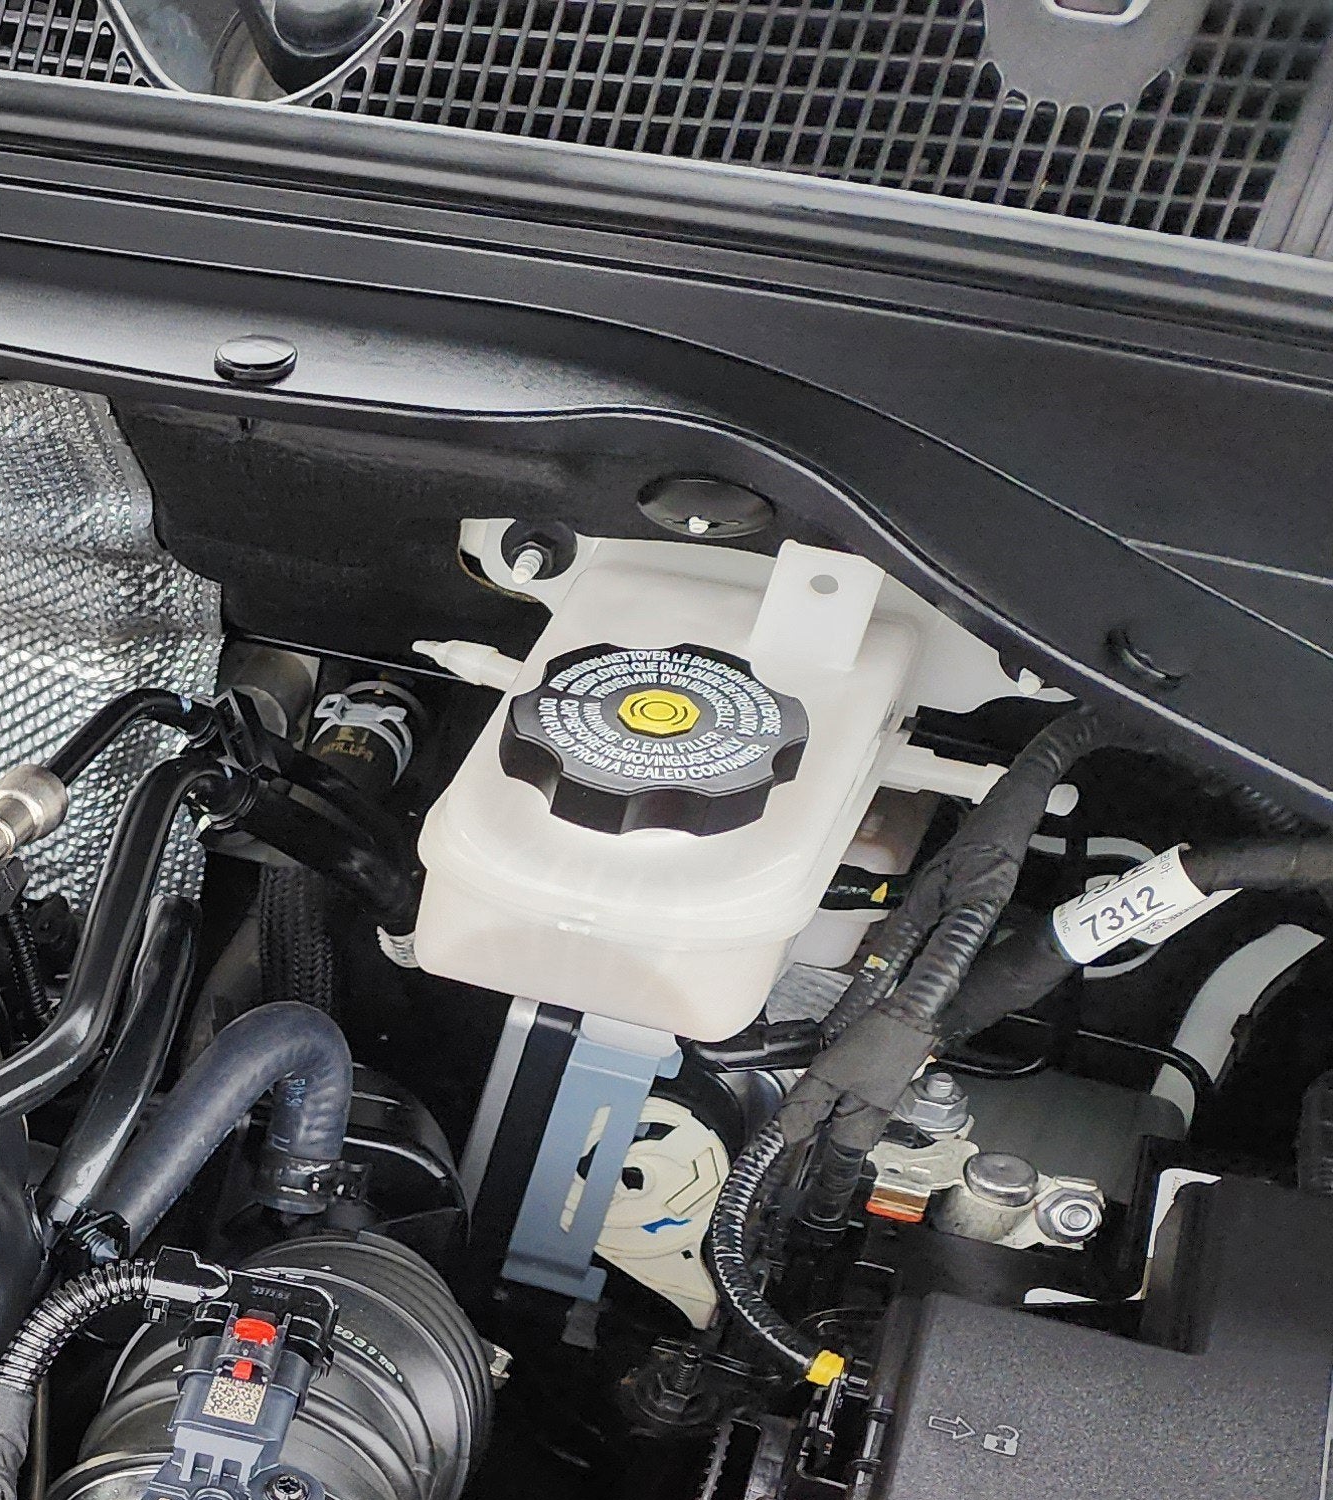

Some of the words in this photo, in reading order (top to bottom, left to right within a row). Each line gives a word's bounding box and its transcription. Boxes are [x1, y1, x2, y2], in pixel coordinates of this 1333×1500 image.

[601, 651, 670, 667] NETTOYER
[673, 653, 691, 665] LE
[690, 656, 749, 683] BOUCHON
[739, 681, 775, 704] AVANT
[630, 661, 658, 673] QUE
[660, 662, 679, 673] DU
[678, 665, 728, 687] LIQUIDE
[589, 672, 660, 699] PROVENANT
[687, 680, 725, 706] BIDON
[718, 682, 741, 696] DE
[560, 699, 580, 717] CAP
[729, 691, 757, 715] FREIN
[563, 717, 607, 751] BEFORE
[583, 702, 622, 744] WARNING:
[622, 738, 674, 754] CLEAN
[676, 732, 725, 754] FILLER
[542, 721, 575, 748] FLUID
[566, 744, 612, 770] FROM
[607, 761, 621, 774] A
[623, 764, 687, 780] SEALED
[681, 751, 712, 766] USE
[710, 737, 744, 759] ONLY
[1079, 885, 1165, 942] 7312
